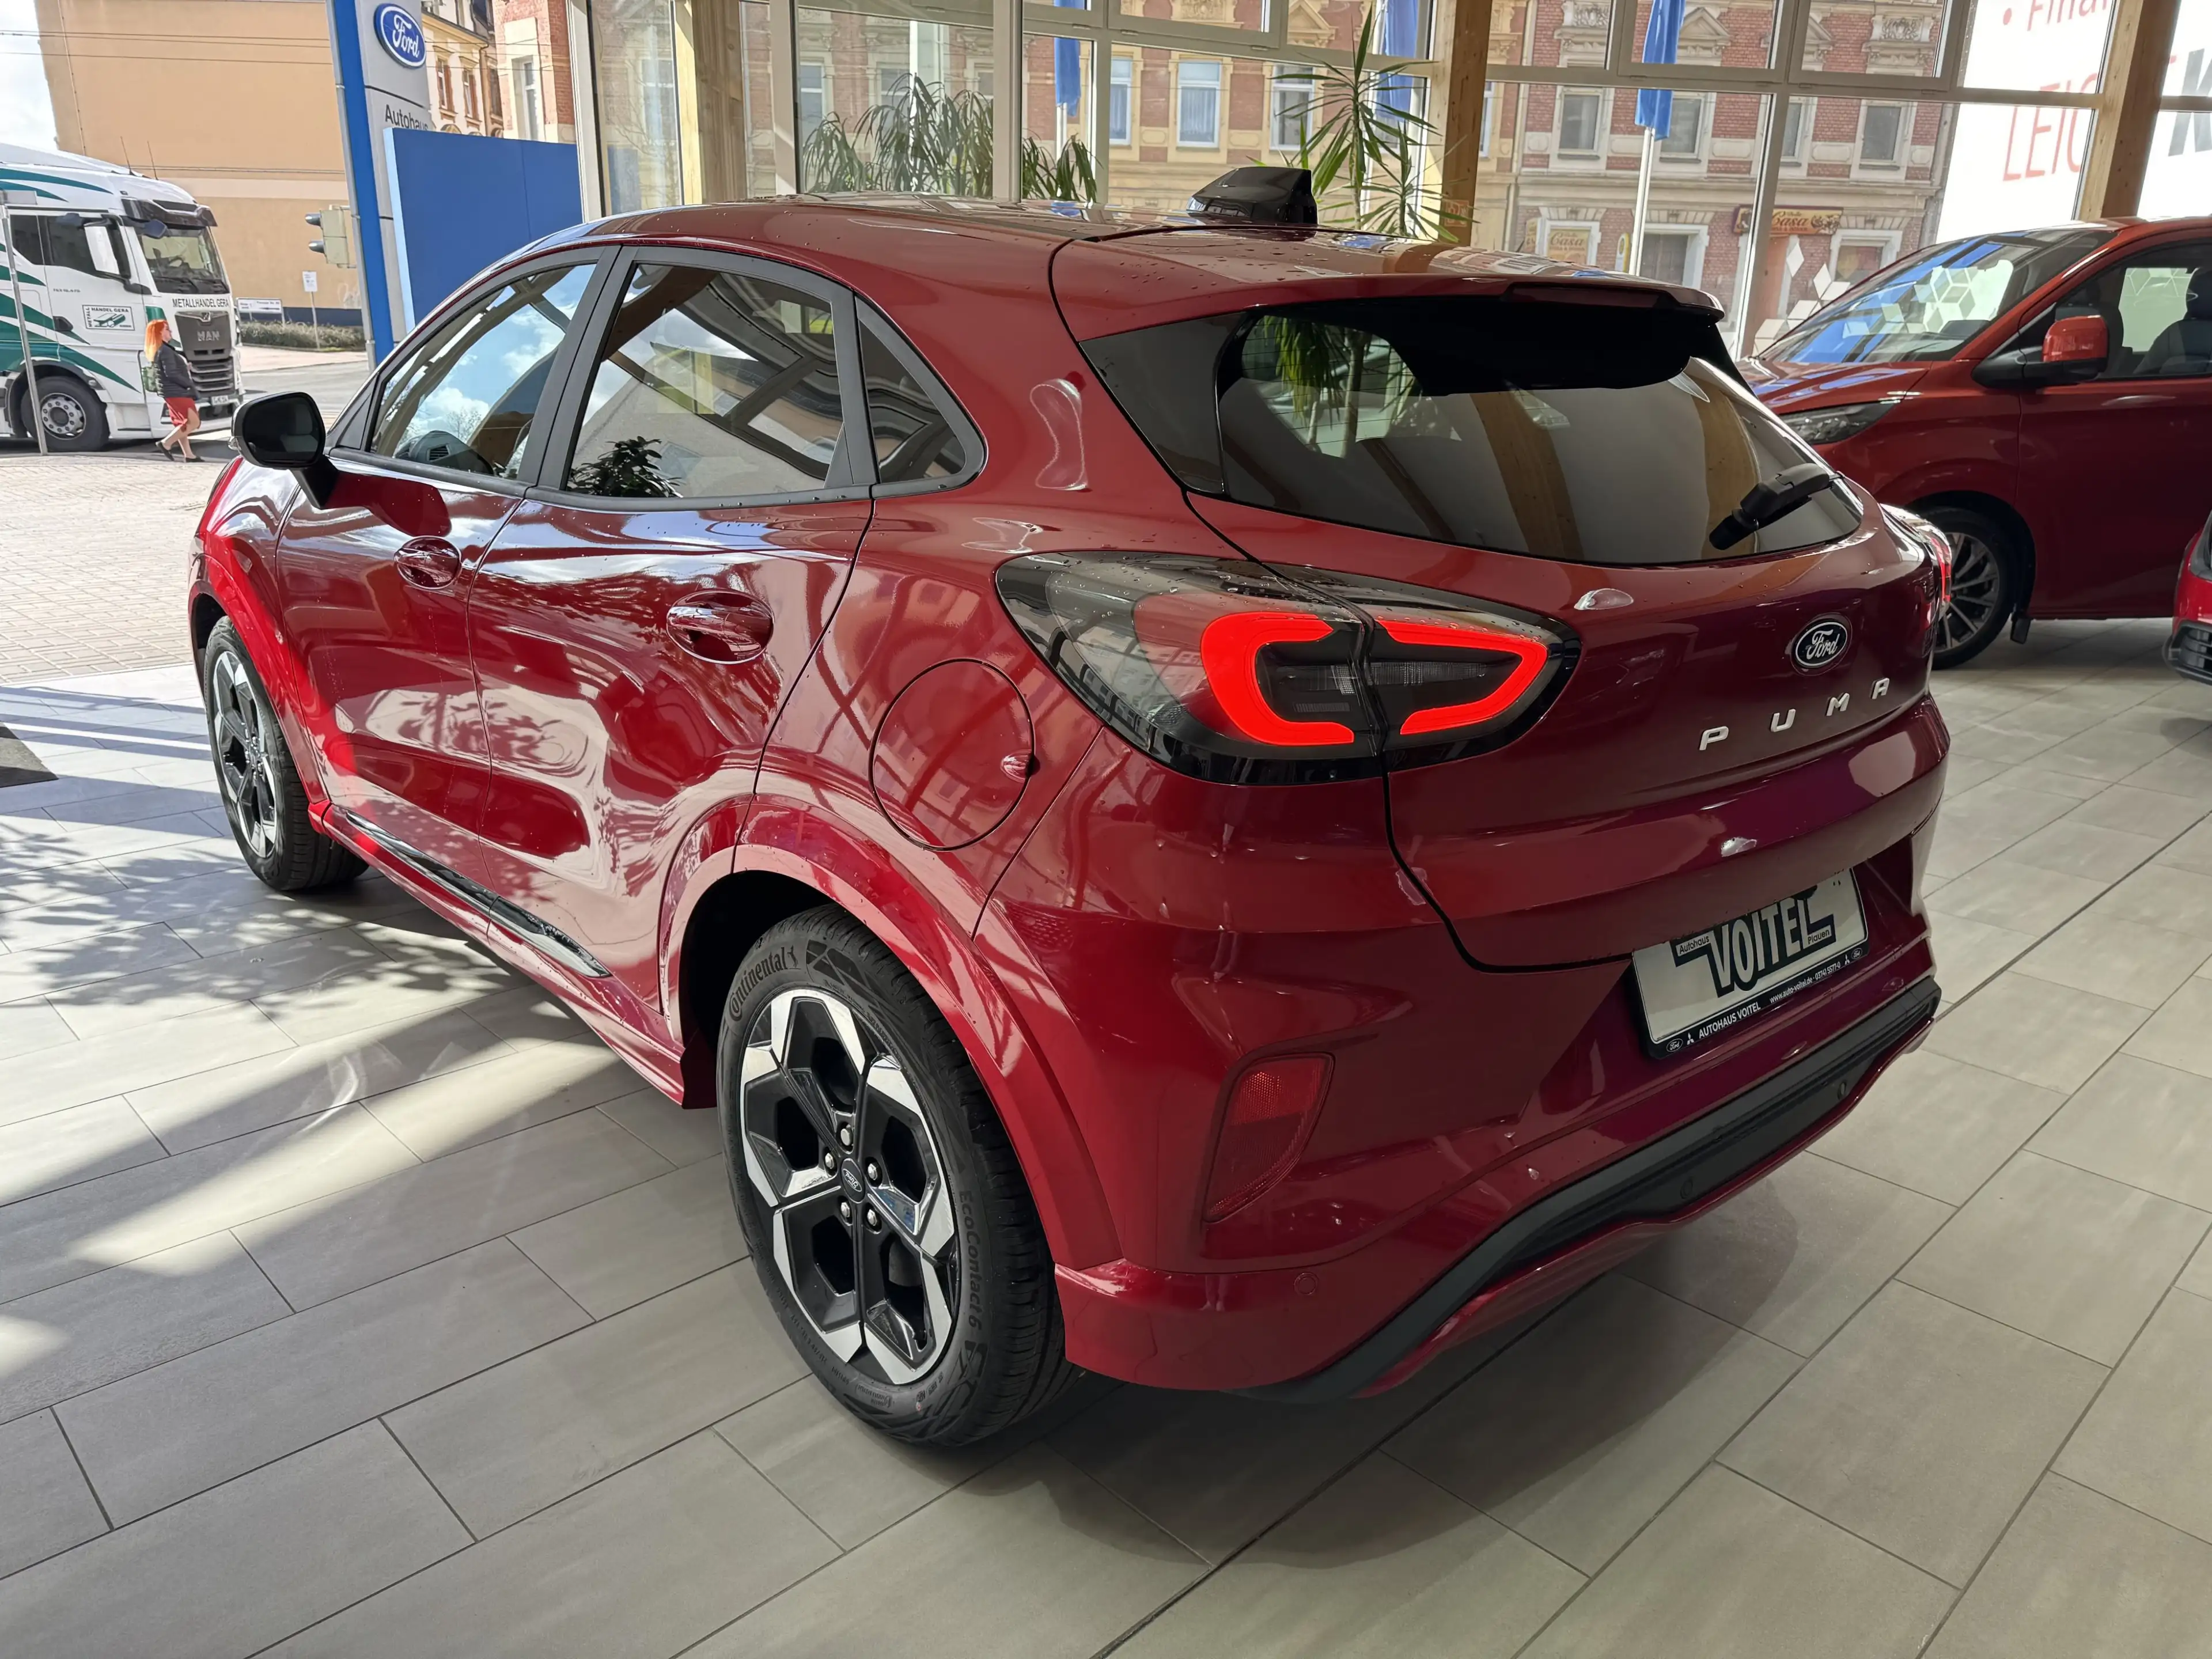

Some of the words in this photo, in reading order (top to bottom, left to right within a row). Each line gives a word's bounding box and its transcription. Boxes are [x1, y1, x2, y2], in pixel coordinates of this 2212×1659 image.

[392, 14, 420, 58] Ford
[1550, 232, 1585, 247] Casa
[173, 298, 216, 308] METALLHANDEL
[216, 299, 229, 308] GERA
[1806, 629, 1840, 660] Ford
[1699, 677, 1890, 751] PUMA
[1679, 935, 1710, 955] Autohaus
[1707, 899, 1811, 989] VOITEL
[1808, 929, 1830, 945] Plauen
[729, 946, 788, 1021] Continental
[1699, 1013, 1737, 1039] AUTOHAUS
[1737, 1002, 1761, 1019] VOITEL
[1770, 977, 1813, 1004] www.auto-voitel.de
[1815, 969, 1827, 980] 03741
[959, 1190, 983, 1315] EcoContact
